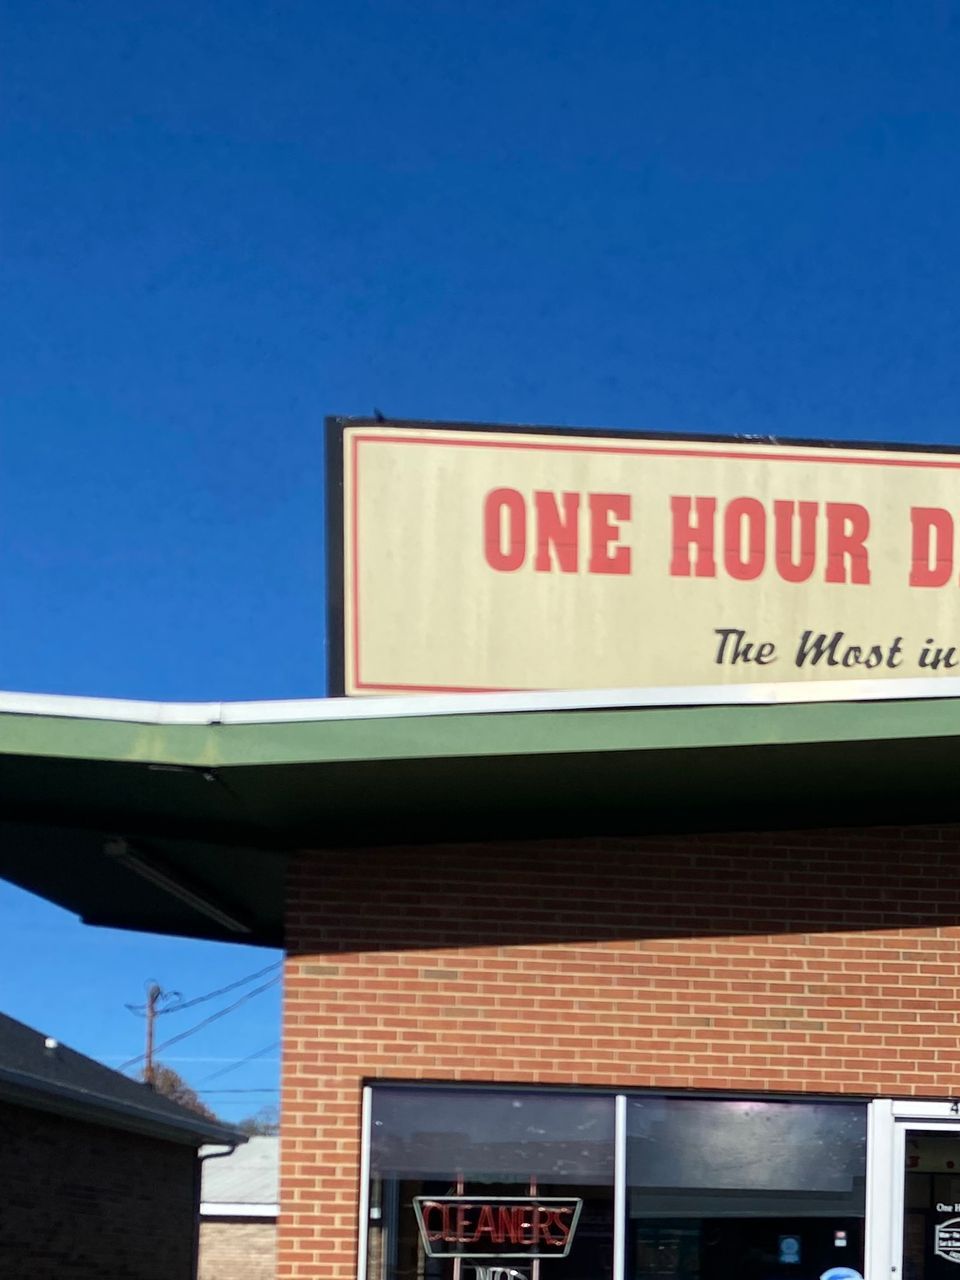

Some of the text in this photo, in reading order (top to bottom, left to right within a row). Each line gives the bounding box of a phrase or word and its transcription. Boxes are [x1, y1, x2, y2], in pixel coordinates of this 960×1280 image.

[482, 486, 632, 575] ONE
[669, 496, 871, 586] HOUR
[713, 627, 778, 667] The
[794, 630, 904, 670] Most
[918, 636, 960, 668] in
[421, 1200, 573, 1246] CLEANERS
[936, 1202, 953, 1212] One
